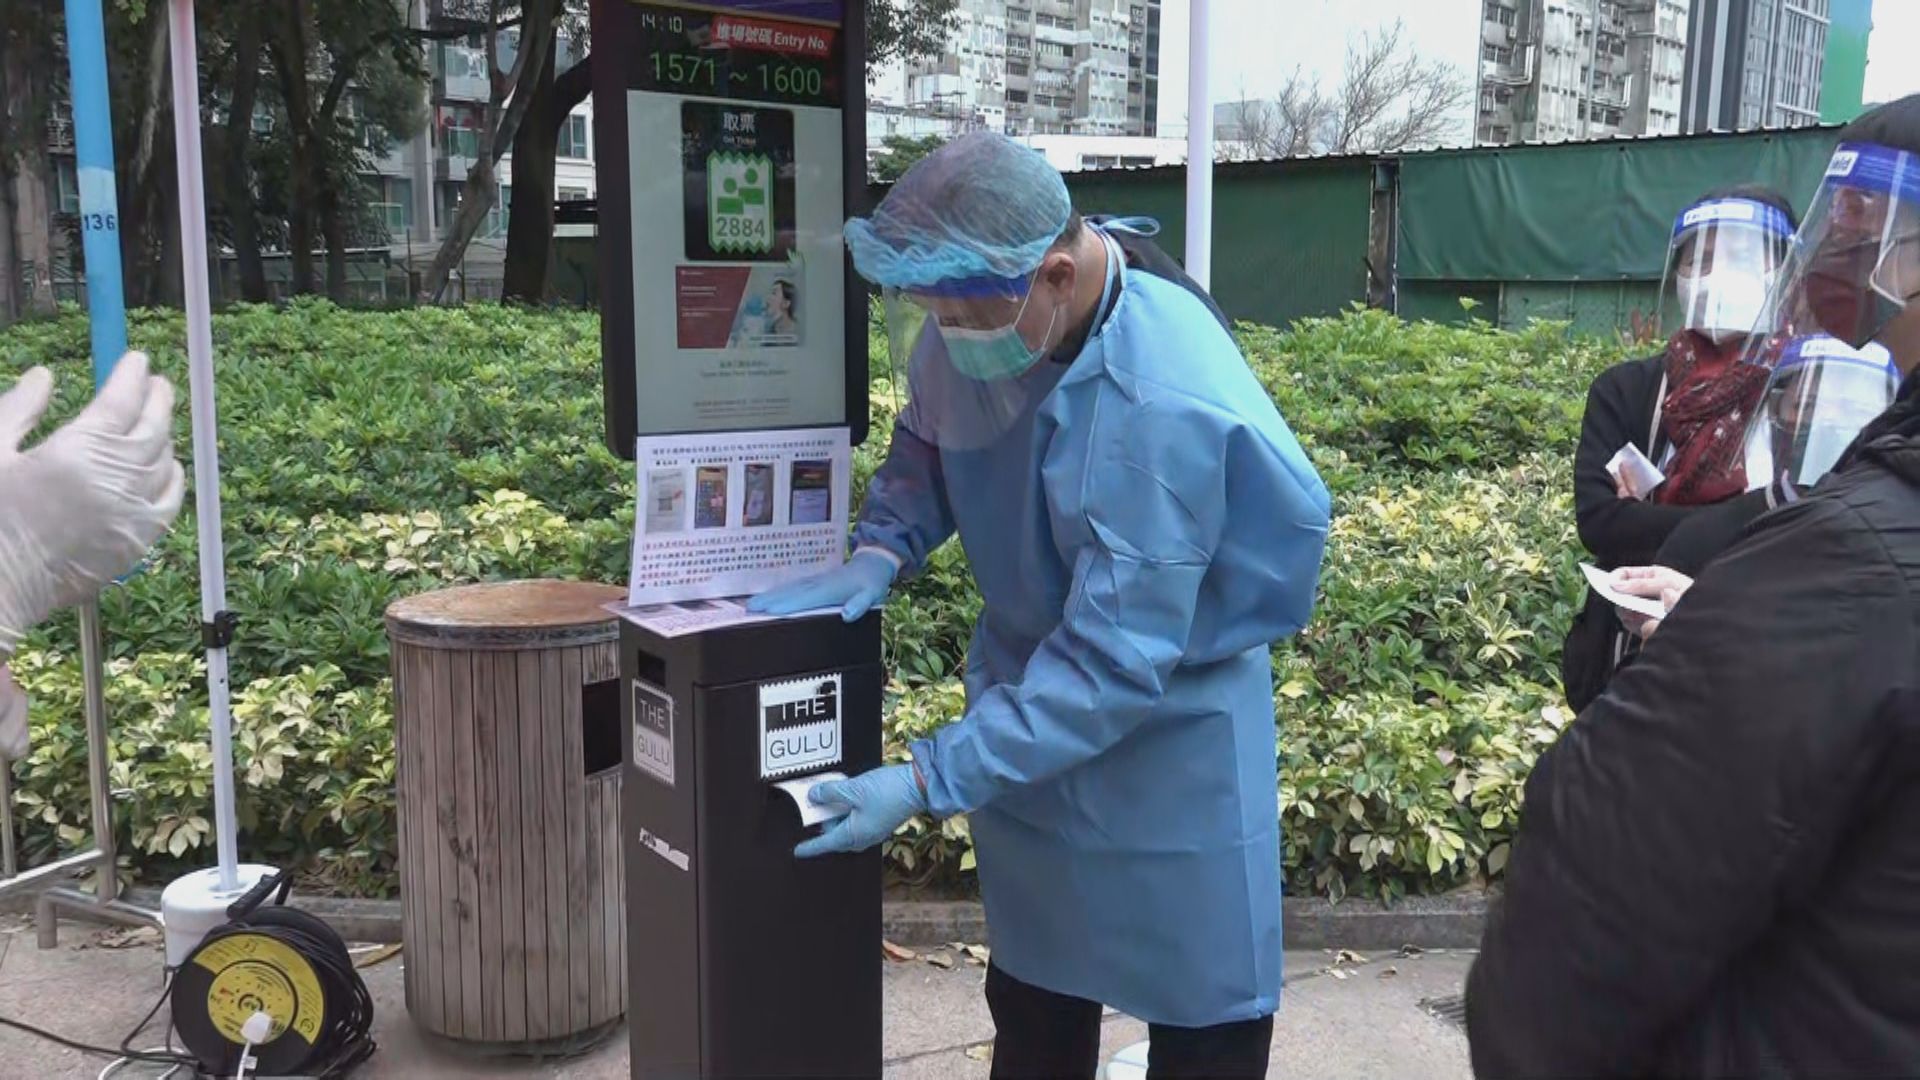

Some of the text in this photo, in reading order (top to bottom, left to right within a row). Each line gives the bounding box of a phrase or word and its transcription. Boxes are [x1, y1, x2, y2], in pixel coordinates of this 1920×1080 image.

[641, 13, 682, 33] 14:10
[774, 32, 806, 51] Entry
[808, 36, 828, 50] No.
[650, 51, 715, 86] 1571
[758, 64, 821, 95] 1600
[84, 214, 116, 231] 136
[716, 216, 766, 237] 2884
[640, 700, 665, 729] THE
[637, 733, 670, 767] GULU
[769, 730, 834, 759] GULU
